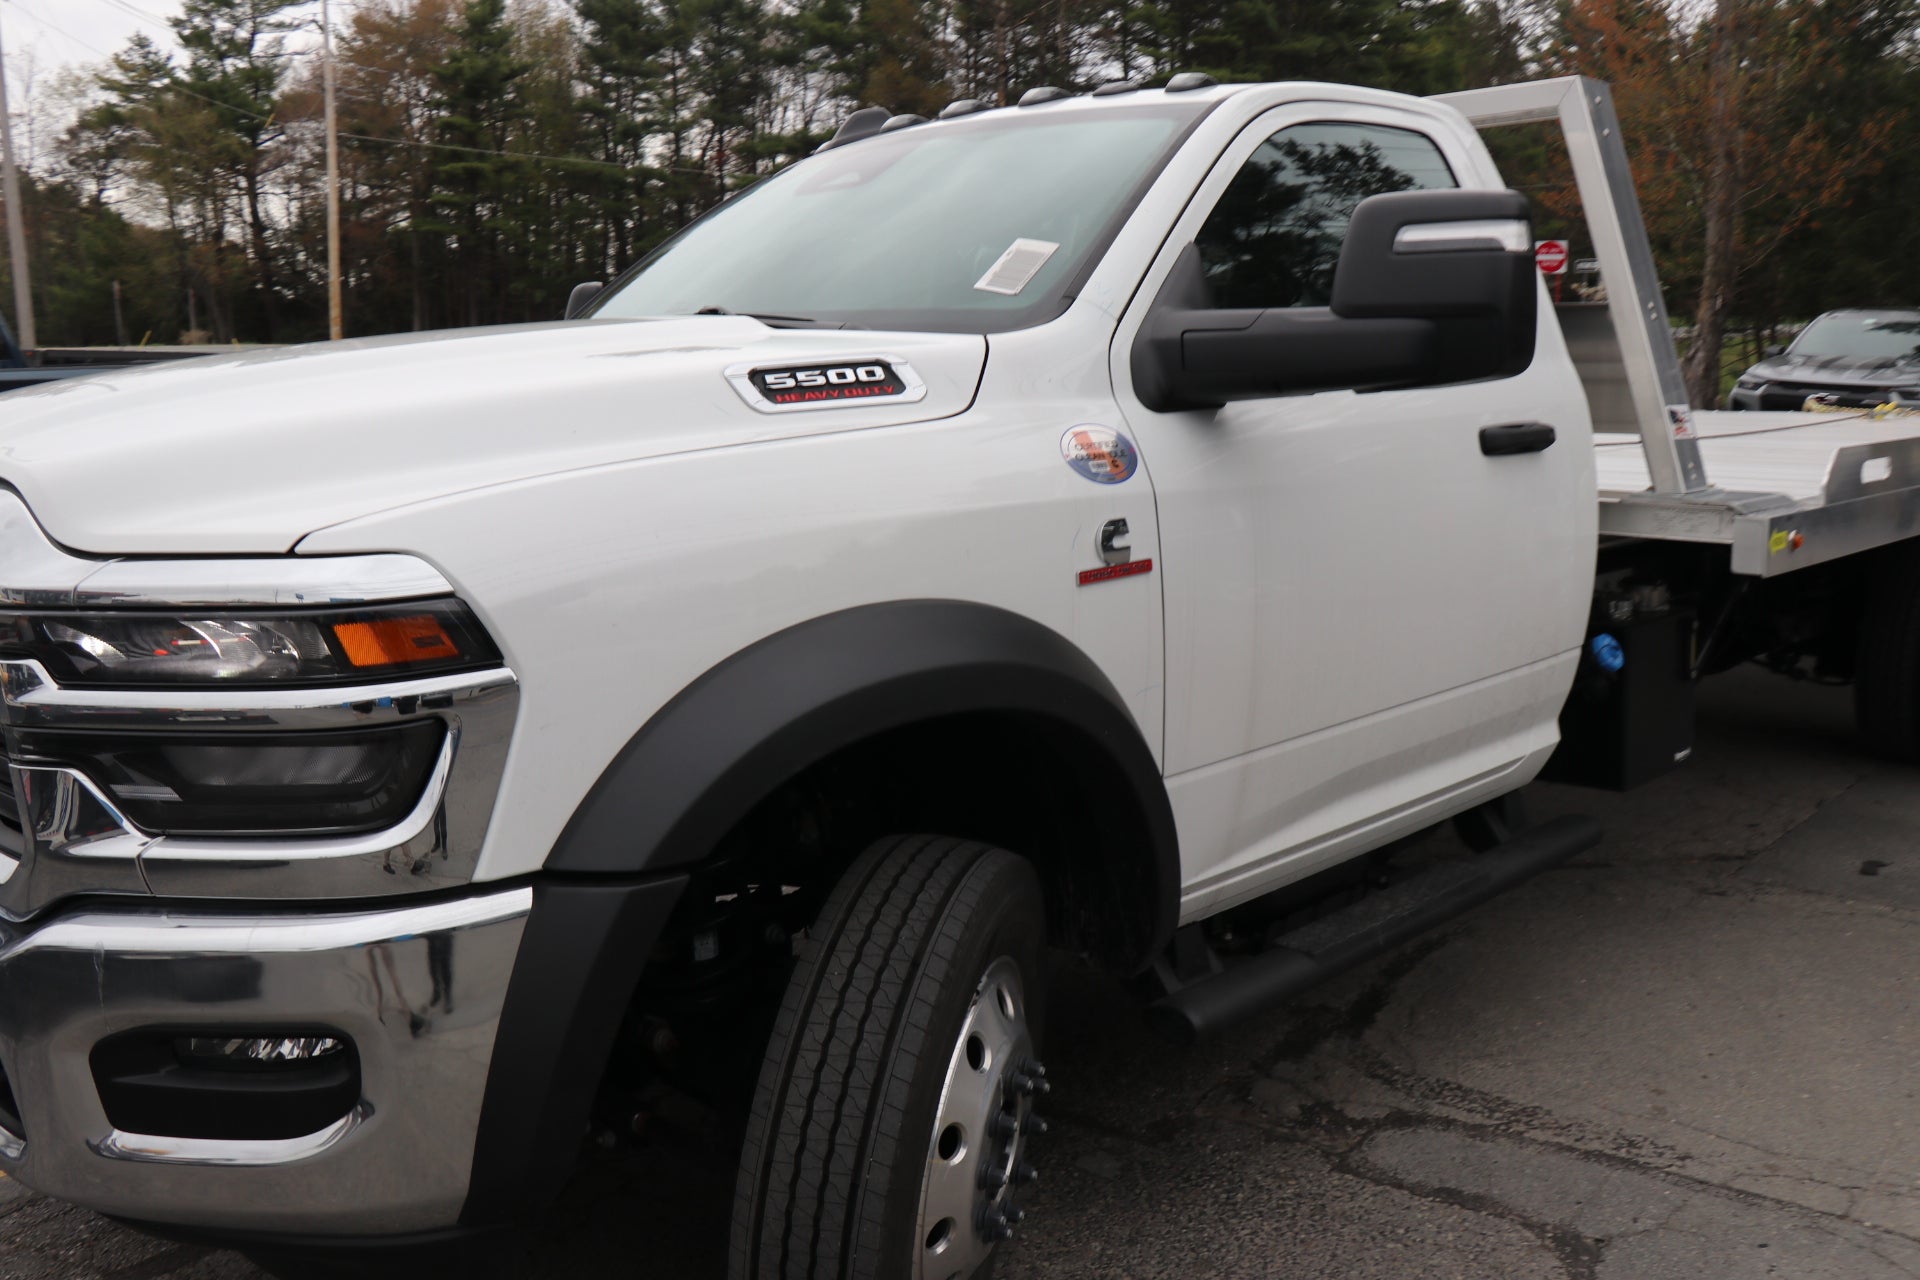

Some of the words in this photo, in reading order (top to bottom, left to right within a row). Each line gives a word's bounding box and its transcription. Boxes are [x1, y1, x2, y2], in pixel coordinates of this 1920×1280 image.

[764, 365, 885, 389] 5500
[776, 389, 839, 402] HEAVY
[844, 385, 895, 398] DUTY
